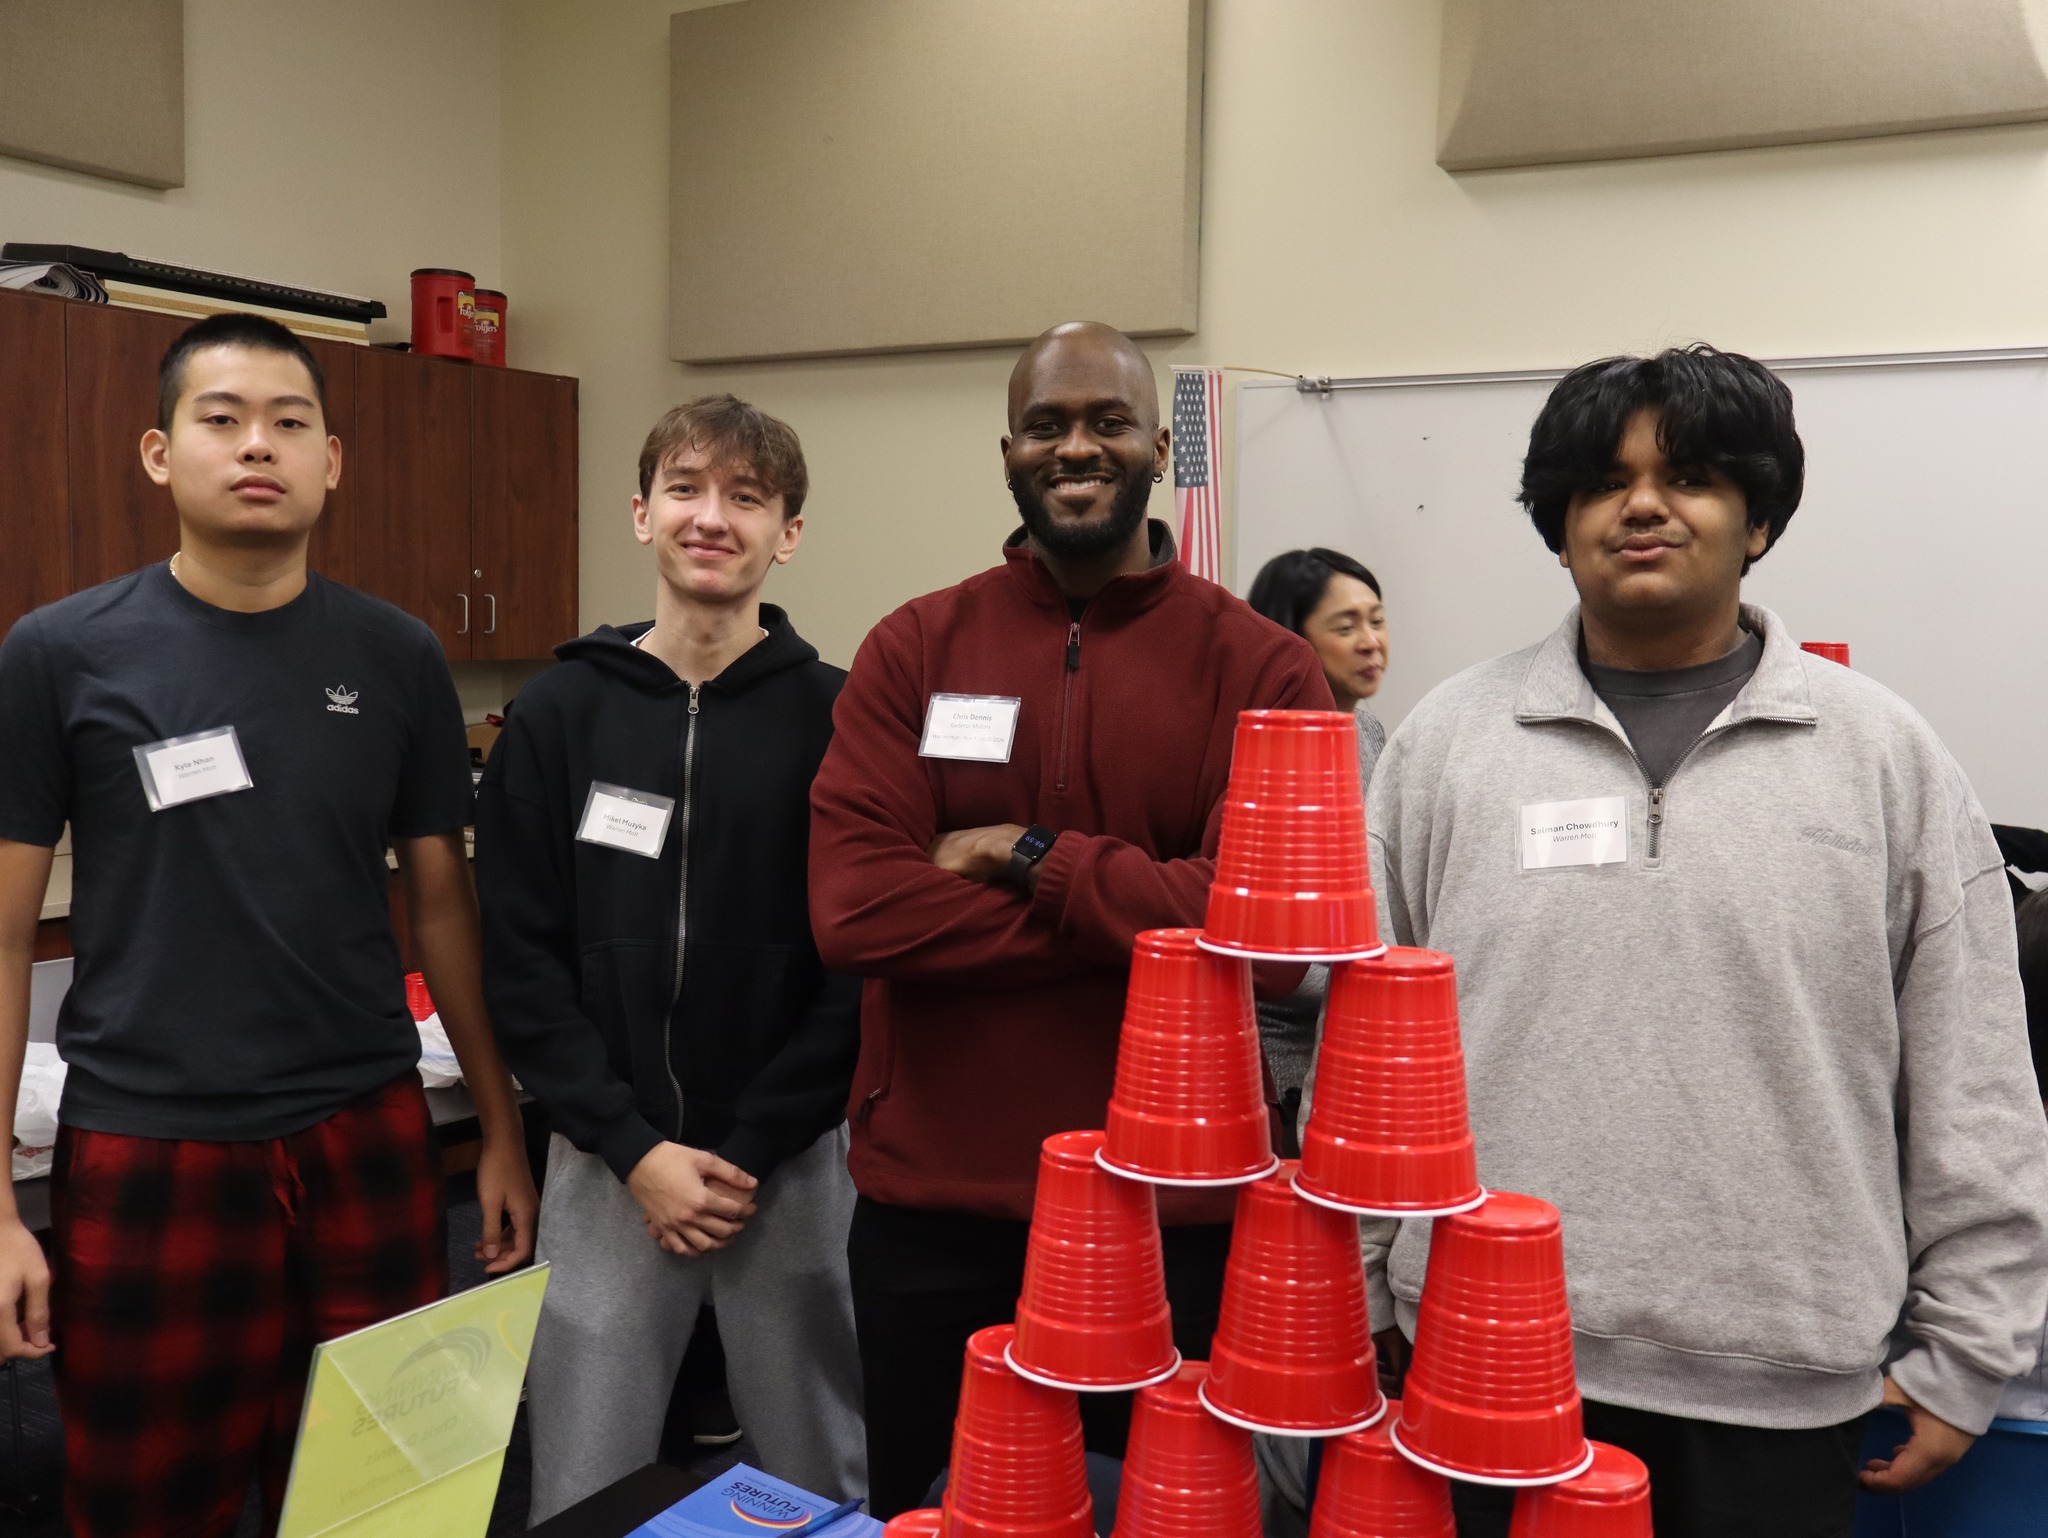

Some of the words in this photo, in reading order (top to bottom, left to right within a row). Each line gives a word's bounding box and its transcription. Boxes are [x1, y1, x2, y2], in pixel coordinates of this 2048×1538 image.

[326, 703, 360, 715] adidas
[952, 712, 968, 720] Chris
[970, 713, 993, 722] Dennis
[950, 722, 971, 730] General
[174, 760, 192, 772] Kyle
[193, 755, 215, 766] Nhan
[603, 813, 622, 825] Mikel
[621, 819, 647, 831] Muzyka
[1530, 825, 1564, 835] Salman
[1566, 820, 1619, 831] Chowdhury
[1552, 834, 1579, 843] Warren
[720, 1487, 789, 1519] WINNING
[729, 1481, 801, 1513] FUTURES
